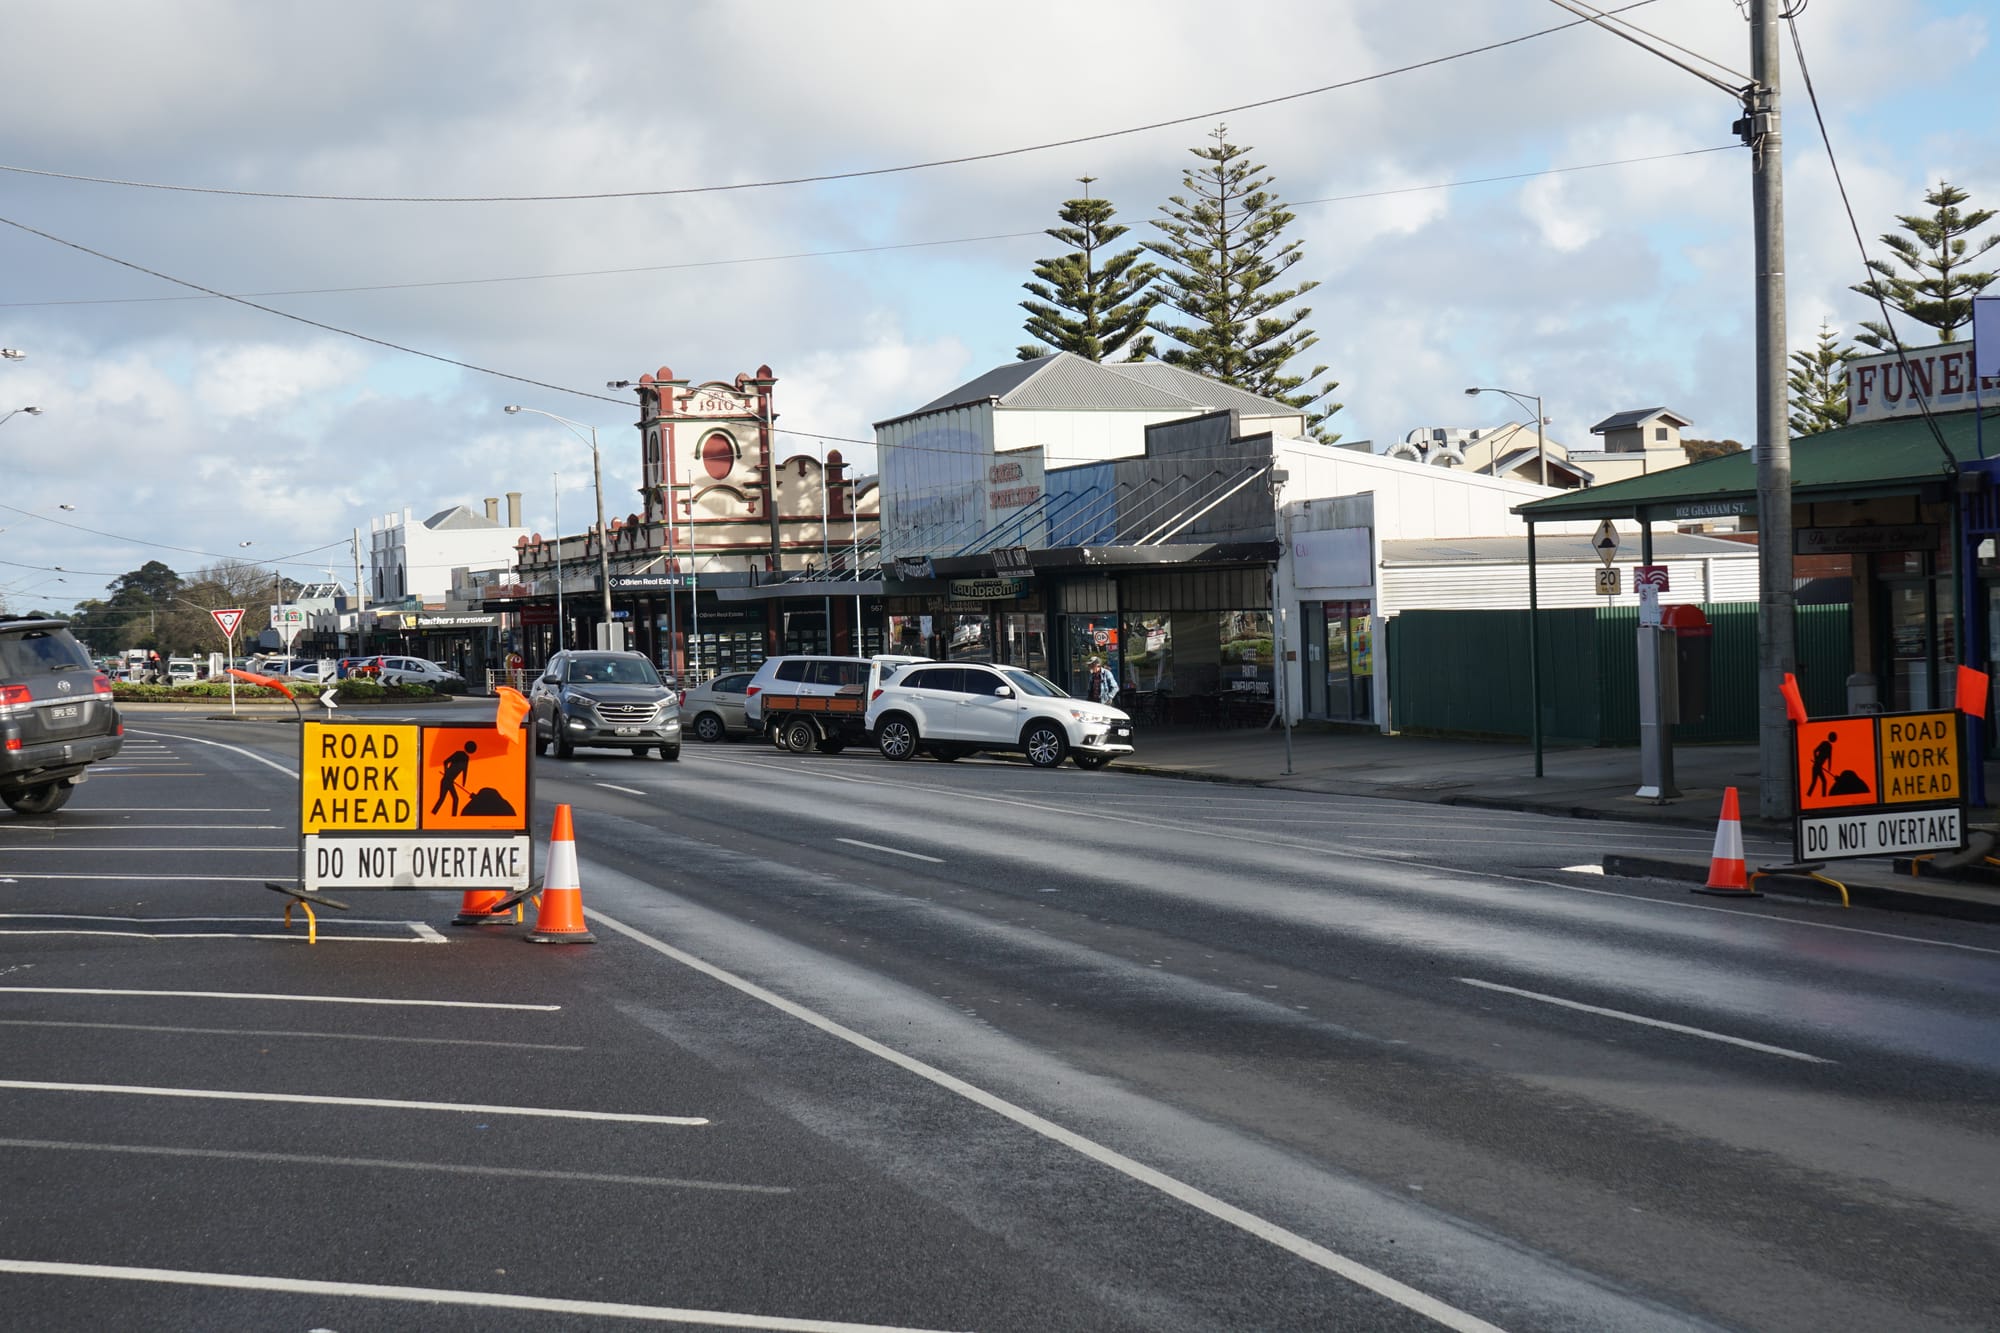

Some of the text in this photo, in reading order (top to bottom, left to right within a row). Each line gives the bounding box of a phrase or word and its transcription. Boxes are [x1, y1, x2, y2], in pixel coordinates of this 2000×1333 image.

[700, 400, 734, 411] 1910
[1691, 503, 1730, 516] GRAHAM
[1732, 502, 1747, 513] ST.
[952, 582, 1025, 597] LAUNDROMAT
[1600, 570, 1616, 586] 20
[418, 616, 494, 625] Panthers menswear
[1890, 721, 1946, 743] ROAD
[322, 733, 399, 759] ROAD
[1890, 746, 1949, 769] WORK
[321, 766, 399, 791] WORK
[1892, 773, 1951, 796] AHEAD
[309, 798, 410, 823] AHEAD
[1808, 815, 1957, 852] DO NOT OVERTAKE
[317, 847, 520, 878] DO NOT OVERTAKE
